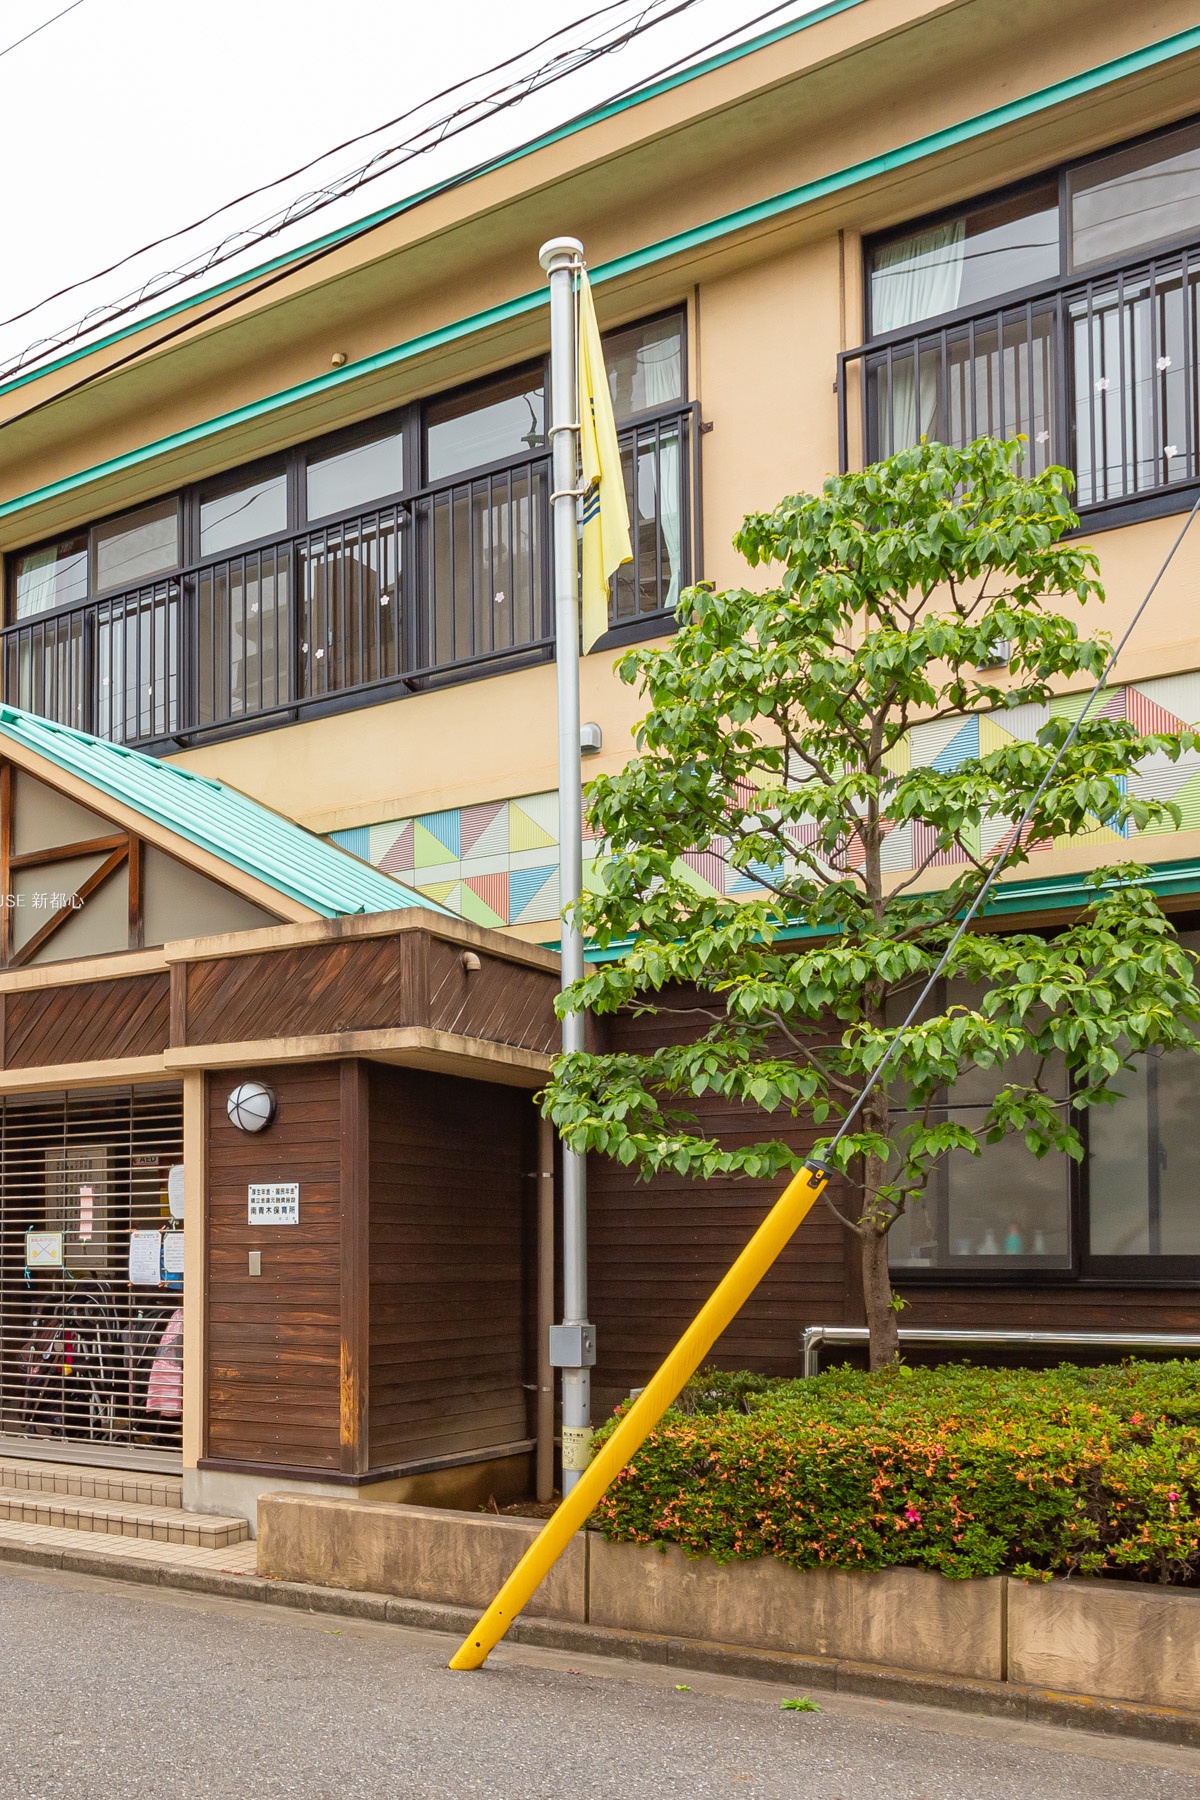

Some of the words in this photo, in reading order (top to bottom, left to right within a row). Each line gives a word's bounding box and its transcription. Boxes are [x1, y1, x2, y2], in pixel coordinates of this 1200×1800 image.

[250, 1205, 296, 1215] 南青木保育所
